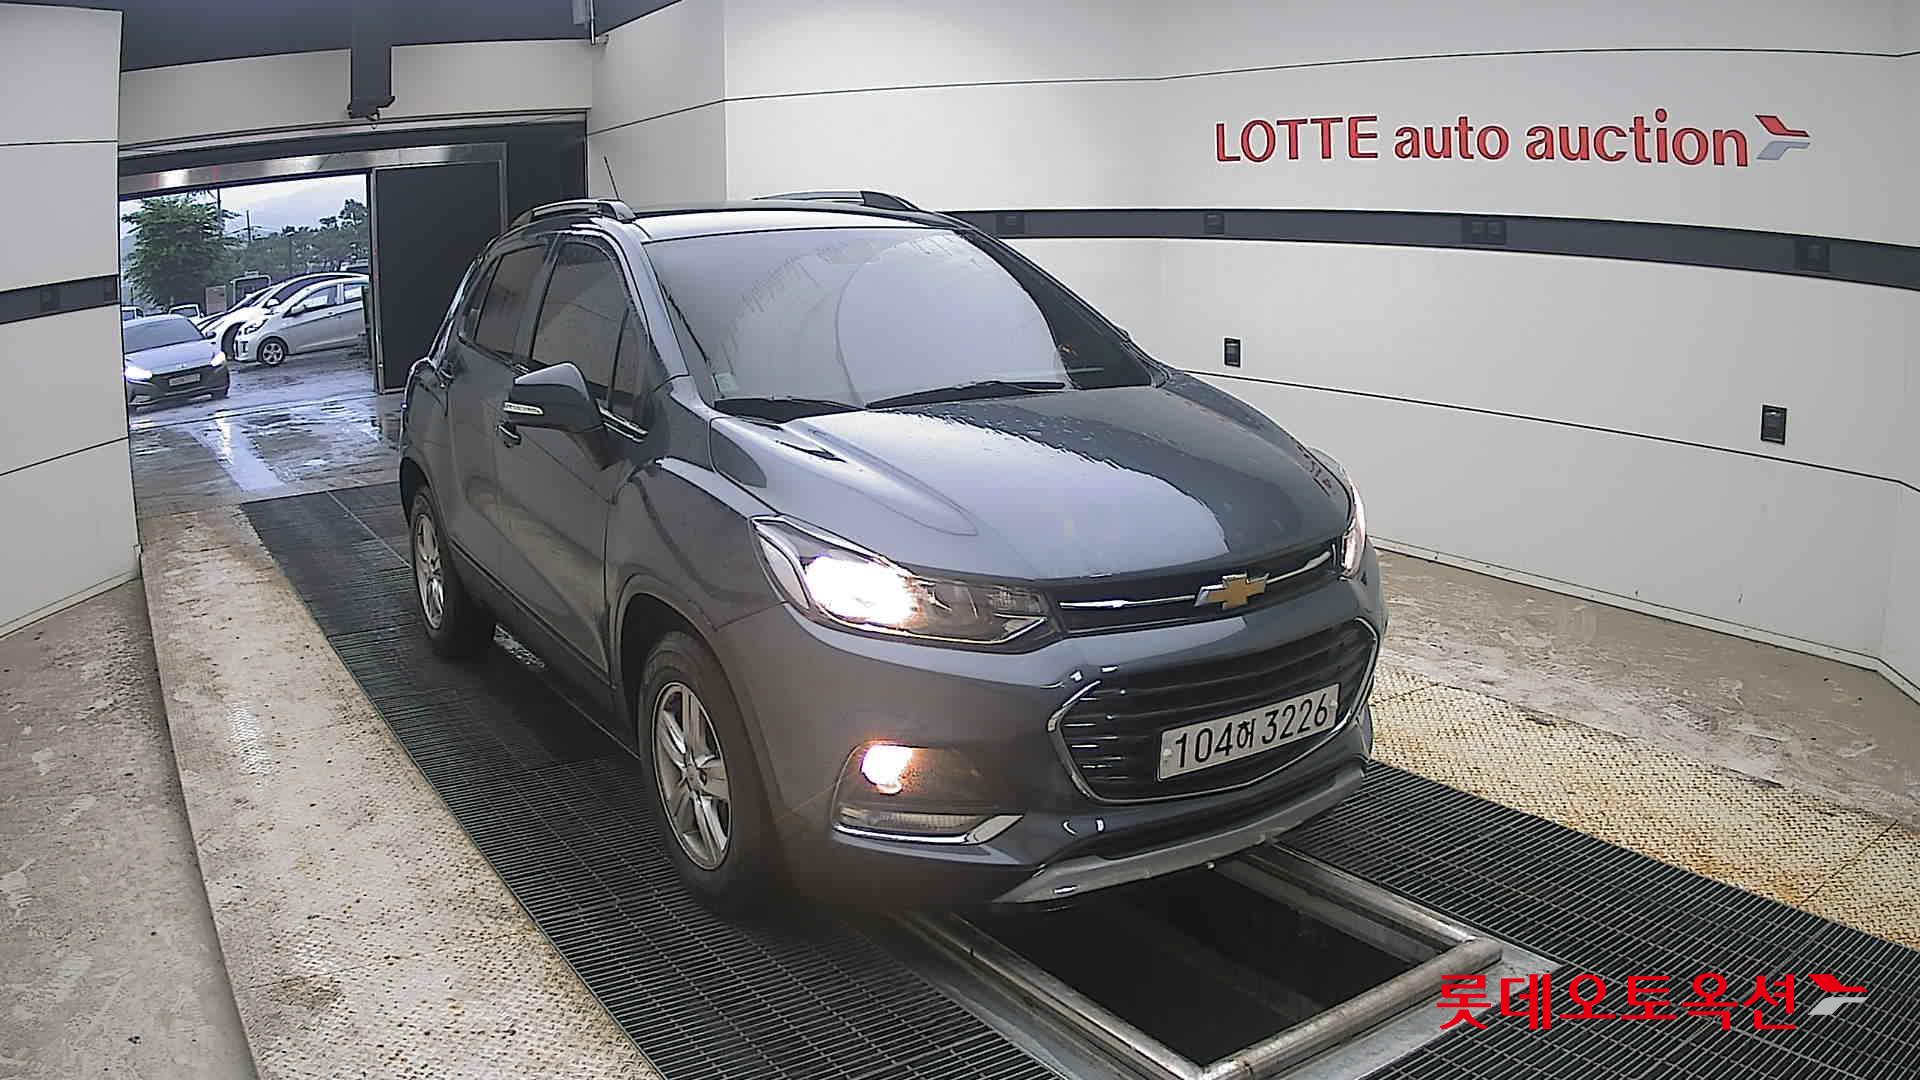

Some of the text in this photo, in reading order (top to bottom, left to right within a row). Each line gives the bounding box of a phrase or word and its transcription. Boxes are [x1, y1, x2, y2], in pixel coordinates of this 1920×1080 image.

[1215, 108, 1749, 167] LOTTE auto auction
[1261, 692, 1329, 744] 3226
